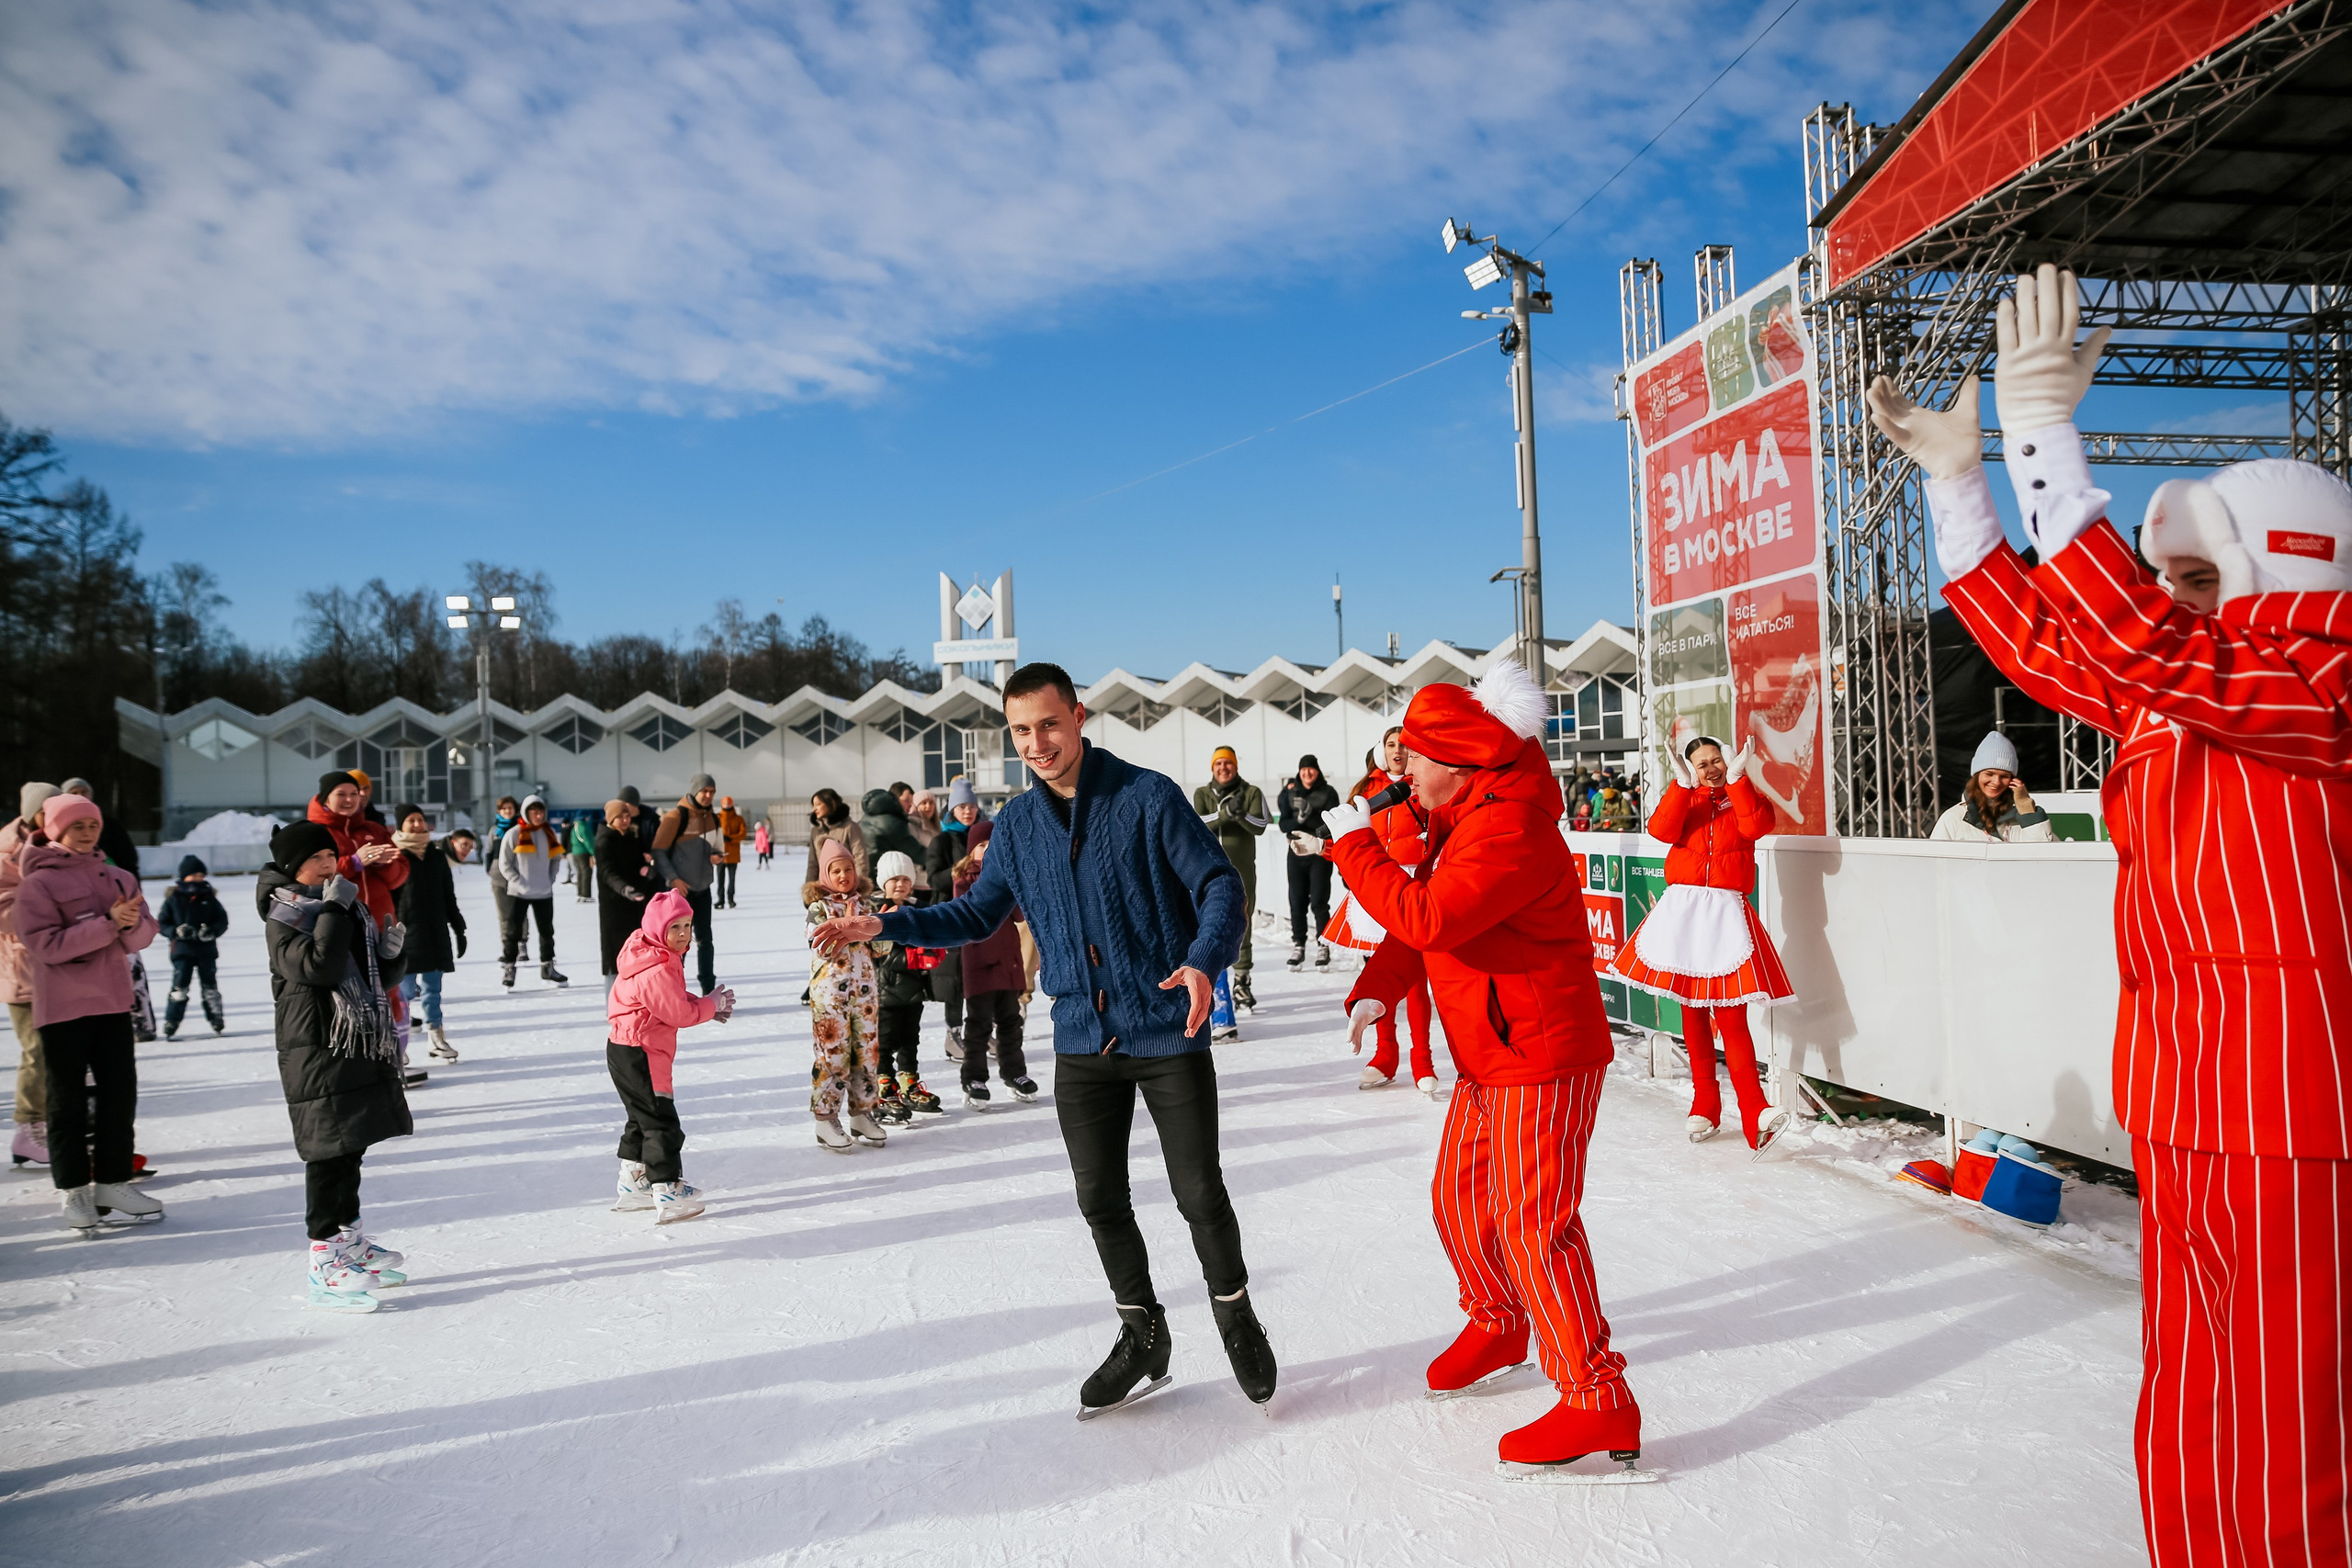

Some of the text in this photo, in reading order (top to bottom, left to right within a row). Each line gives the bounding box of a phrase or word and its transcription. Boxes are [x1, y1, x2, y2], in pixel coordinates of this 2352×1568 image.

[1660, 427, 1791, 532] ЗИМА
[1664, 501, 1793, 575] В МОСКВЕ
[1735, 603, 1757, 622] ВСЕ
[1736, 615, 1795, 641] КАТАТЬСЯ!
[936, 643, 1015, 653] СОКОЛЬНИКИ
[1657, 640, 1678, 657] ВСЕ
[1679, 637, 1687, 652] В
[1631, 866, 1642, 875] ВСЕ
